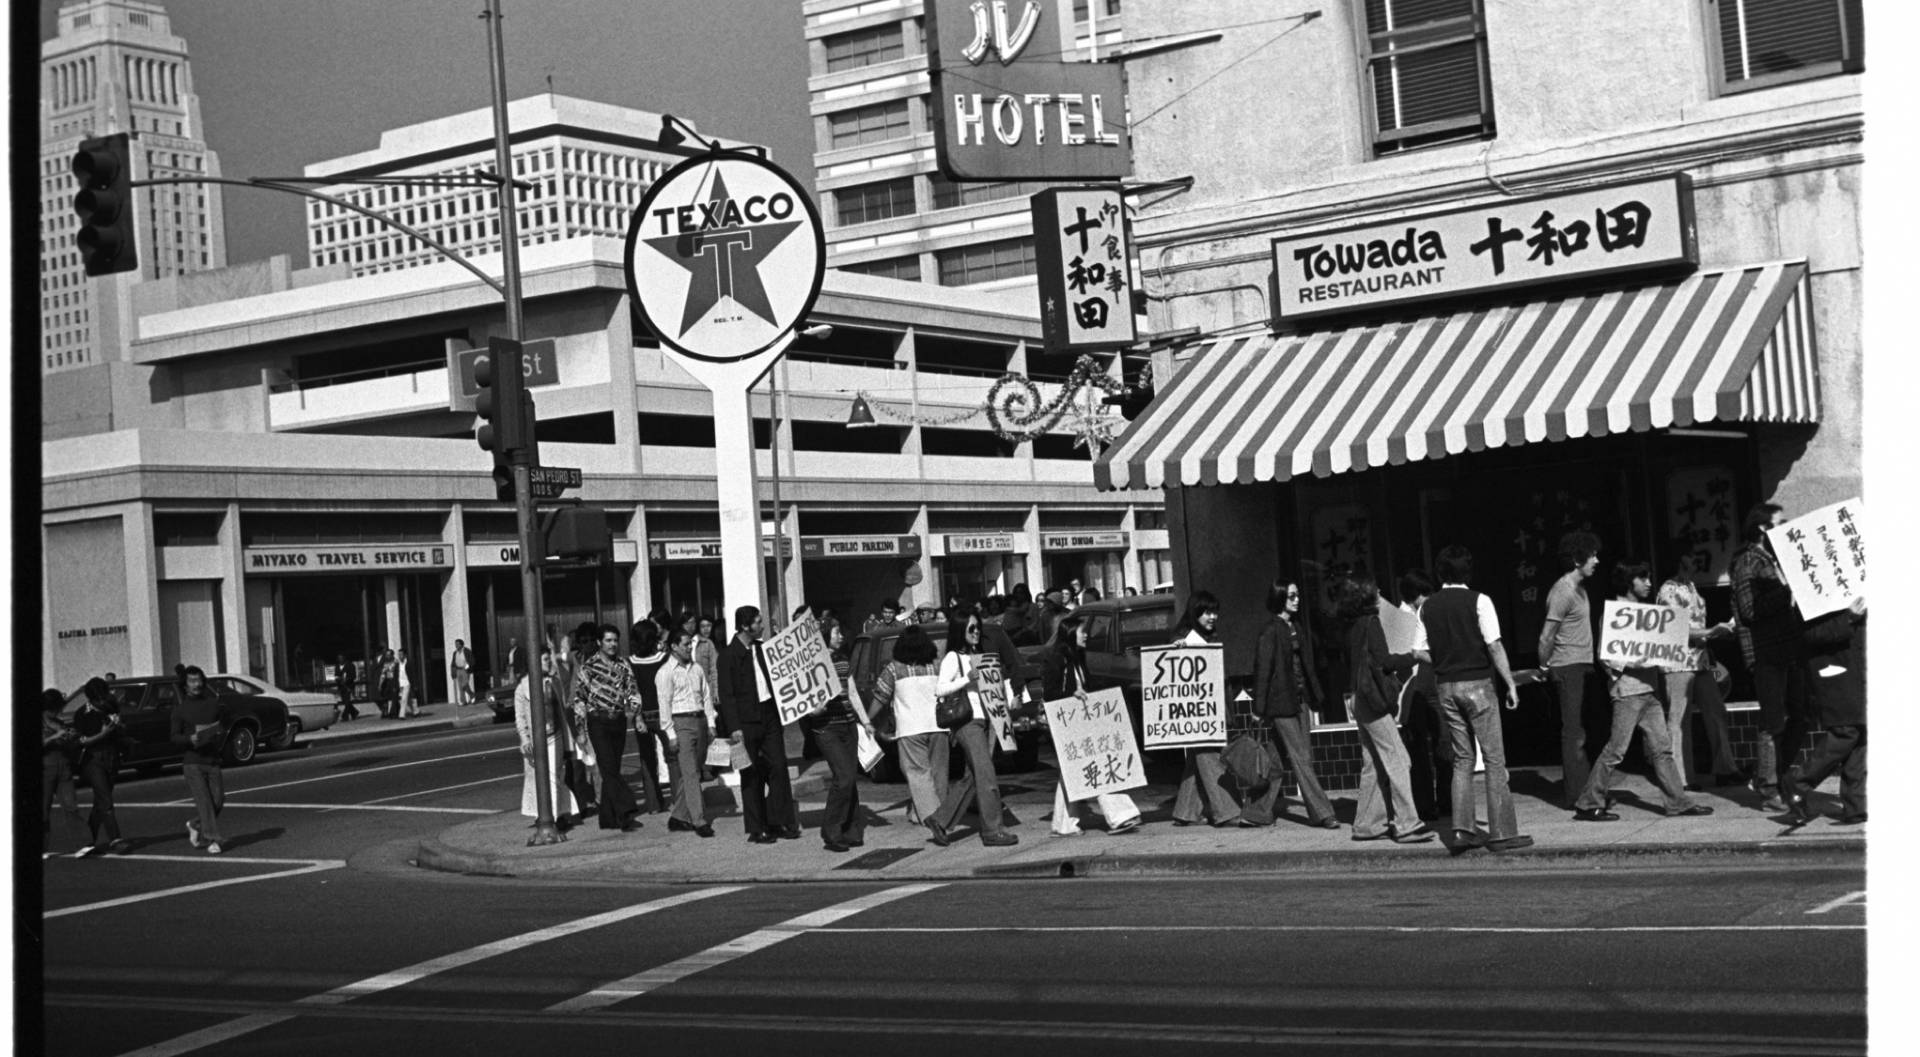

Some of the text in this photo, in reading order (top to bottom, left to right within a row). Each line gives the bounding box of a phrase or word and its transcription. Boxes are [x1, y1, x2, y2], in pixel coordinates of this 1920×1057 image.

[954, 93, 1119, 146] HOTEL
[653, 192, 794, 235] TEXACO
[1099, 200, 1127, 304] 御食事
[1294, 227, 1447, 282] Towada
[1470, 200, 1651, 276] 十和田
[1064, 207, 1109, 329] 十和田
[1299, 266, 1445, 303] RESTAURANT
[522, 353, 542, 377] St
[530, 469, 545, 483] SAN
[546, 469, 569, 484] PEDRO
[252, 551, 426, 568] MIYAKO TRAVEL SERVICE
[830, 541, 894, 553] PUBLIC PARKING
[1514, 528, 1538, 602] 十和田
[1610, 607, 1675, 634] STOP
[770, 638, 822, 681] SERVICES
[981, 669, 1001, 684] NO
[1152, 652, 1207, 685] STOP
[781, 681, 833, 722] hotel
[1143, 682, 1214, 702] EVICTIONS!
